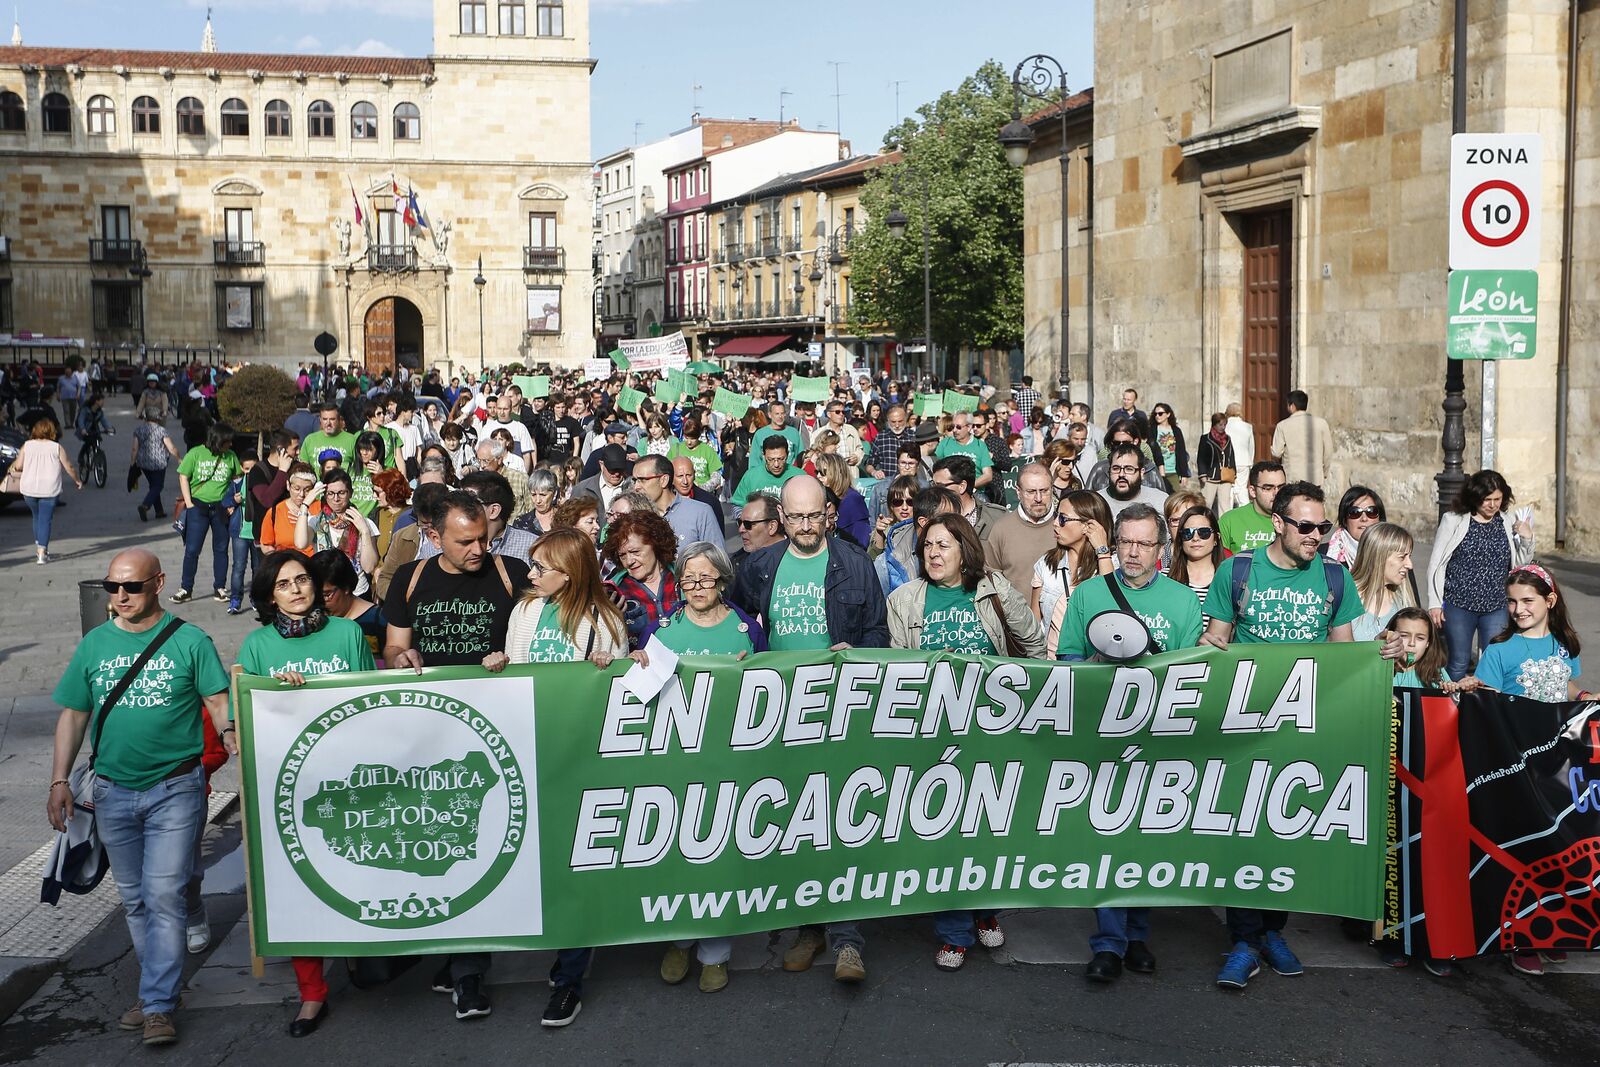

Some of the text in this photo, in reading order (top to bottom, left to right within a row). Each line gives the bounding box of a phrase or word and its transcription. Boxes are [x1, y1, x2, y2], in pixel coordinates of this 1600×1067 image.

[1466, 148, 1528, 164] ZONA
[1483, 204, 1511, 225] 10
[597, 657, 1318, 758] EN DEFENSA DE LA
[278, 691, 526, 864] PLATAFORMA POR LA EDUCACIÓN PÚBLICA
[322, 766, 407, 792] ESCUELA
[344, 810, 381, 829] DE
[568, 744, 1368, 872] EDUCACIÓN PÚBLICA
[329, 842, 394, 863] PARA
[641, 854, 1296, 923] www.edupublicaleon.es
[358, 892, 452, 921] LEÓN
